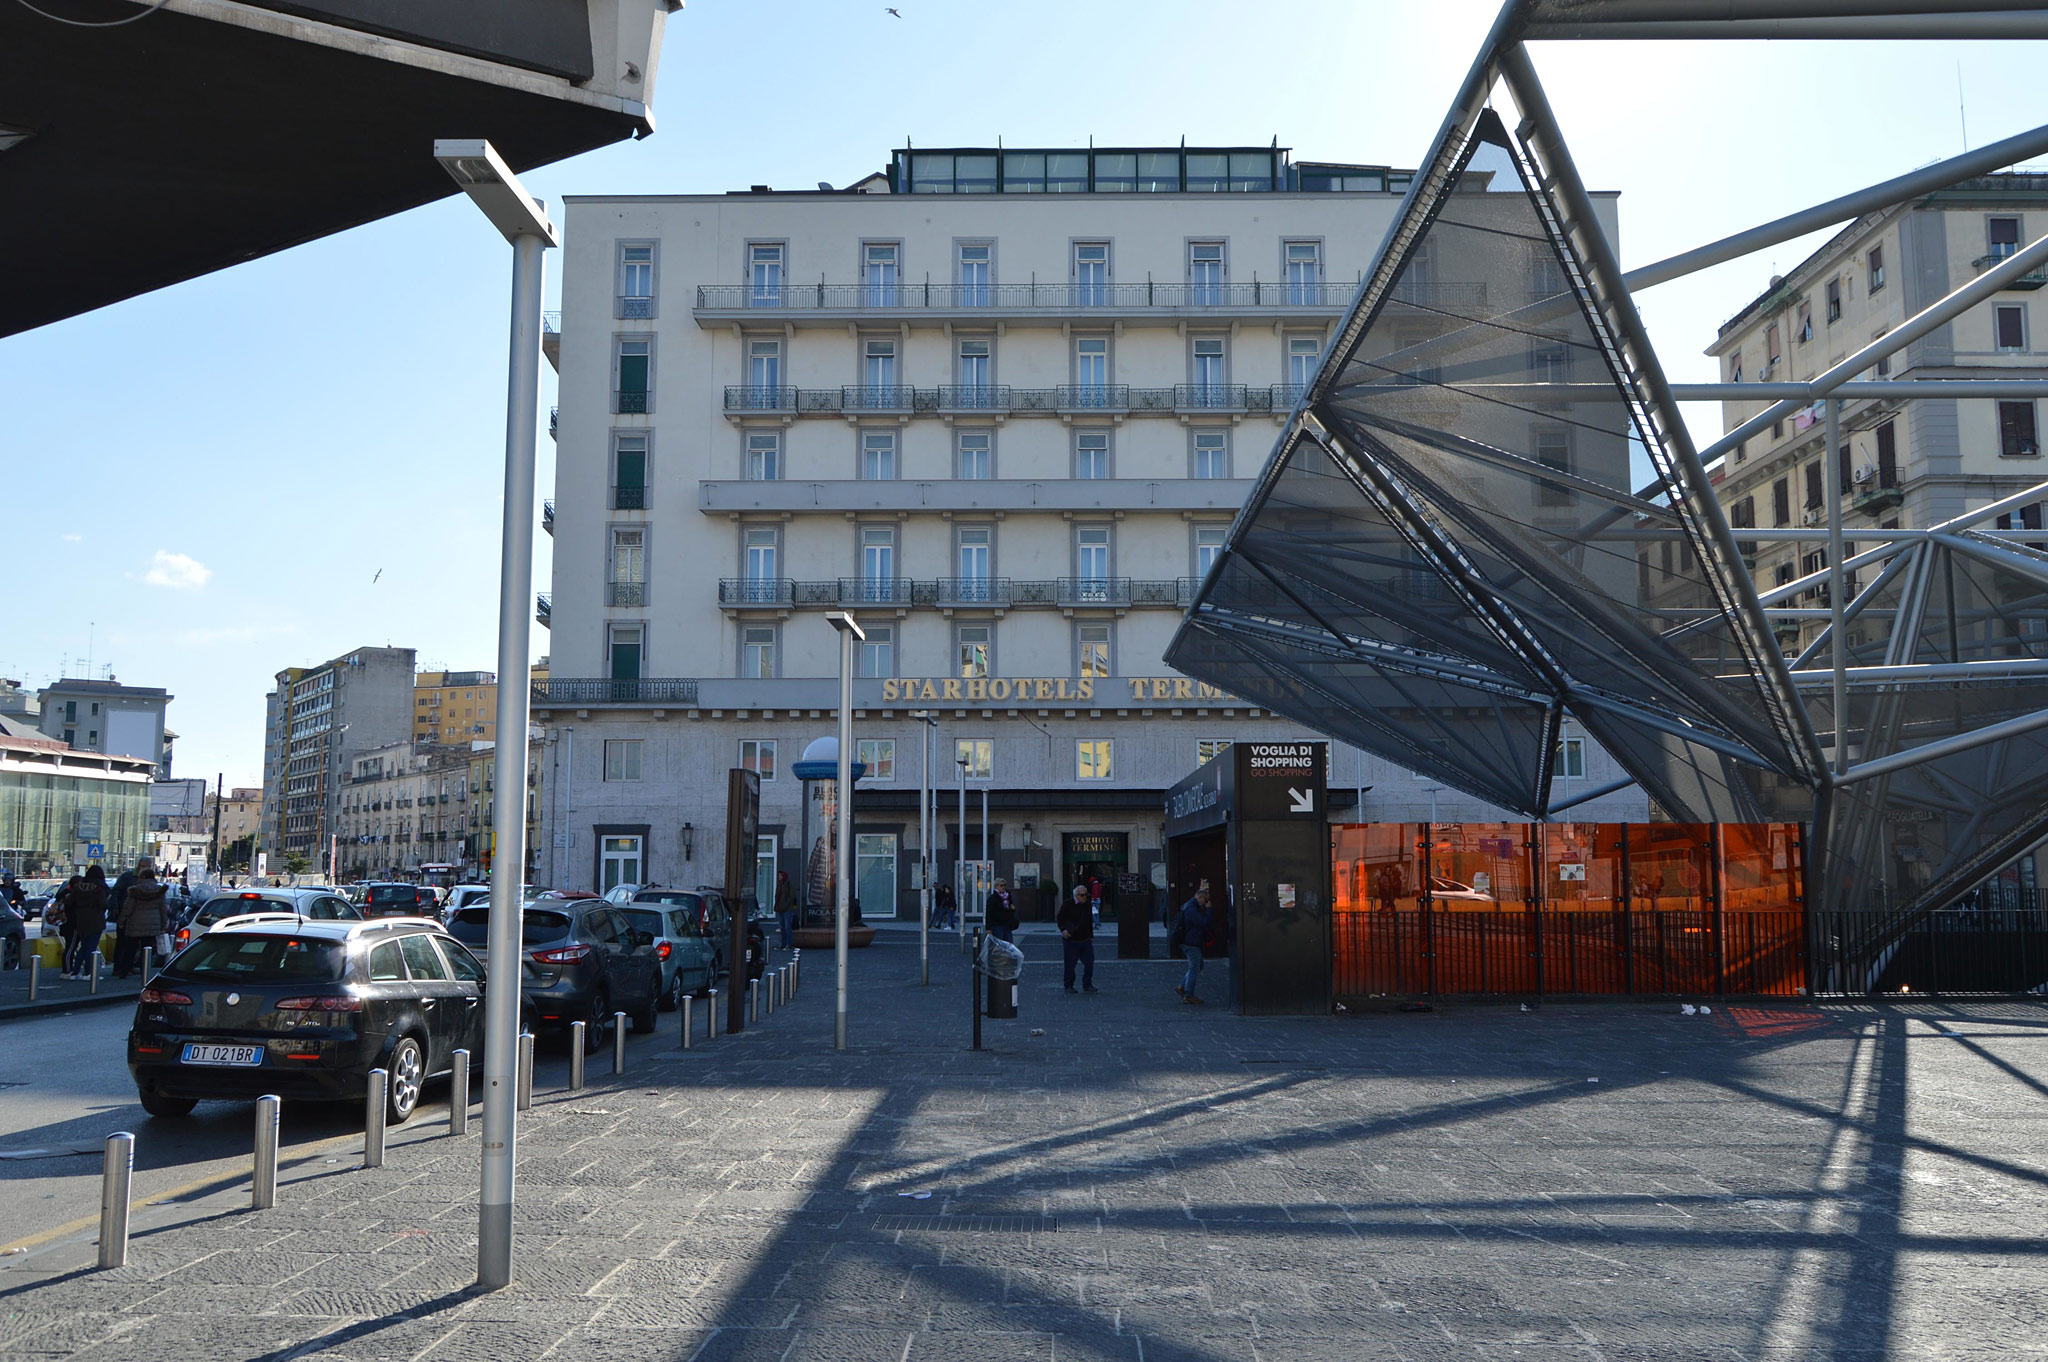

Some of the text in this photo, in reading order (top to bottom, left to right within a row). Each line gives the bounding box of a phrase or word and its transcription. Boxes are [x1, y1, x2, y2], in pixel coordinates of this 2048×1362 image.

[883, 678, 1095, 701] STARHOTELS
[1251, 745, 1312, 756] VOGLIA DI
[1251, 757, 1312, 767] SHOPPING
[1251, 768, 1312, 777] GO SHOPPING
[191, 1046, 253, 1061] DT 021BR
